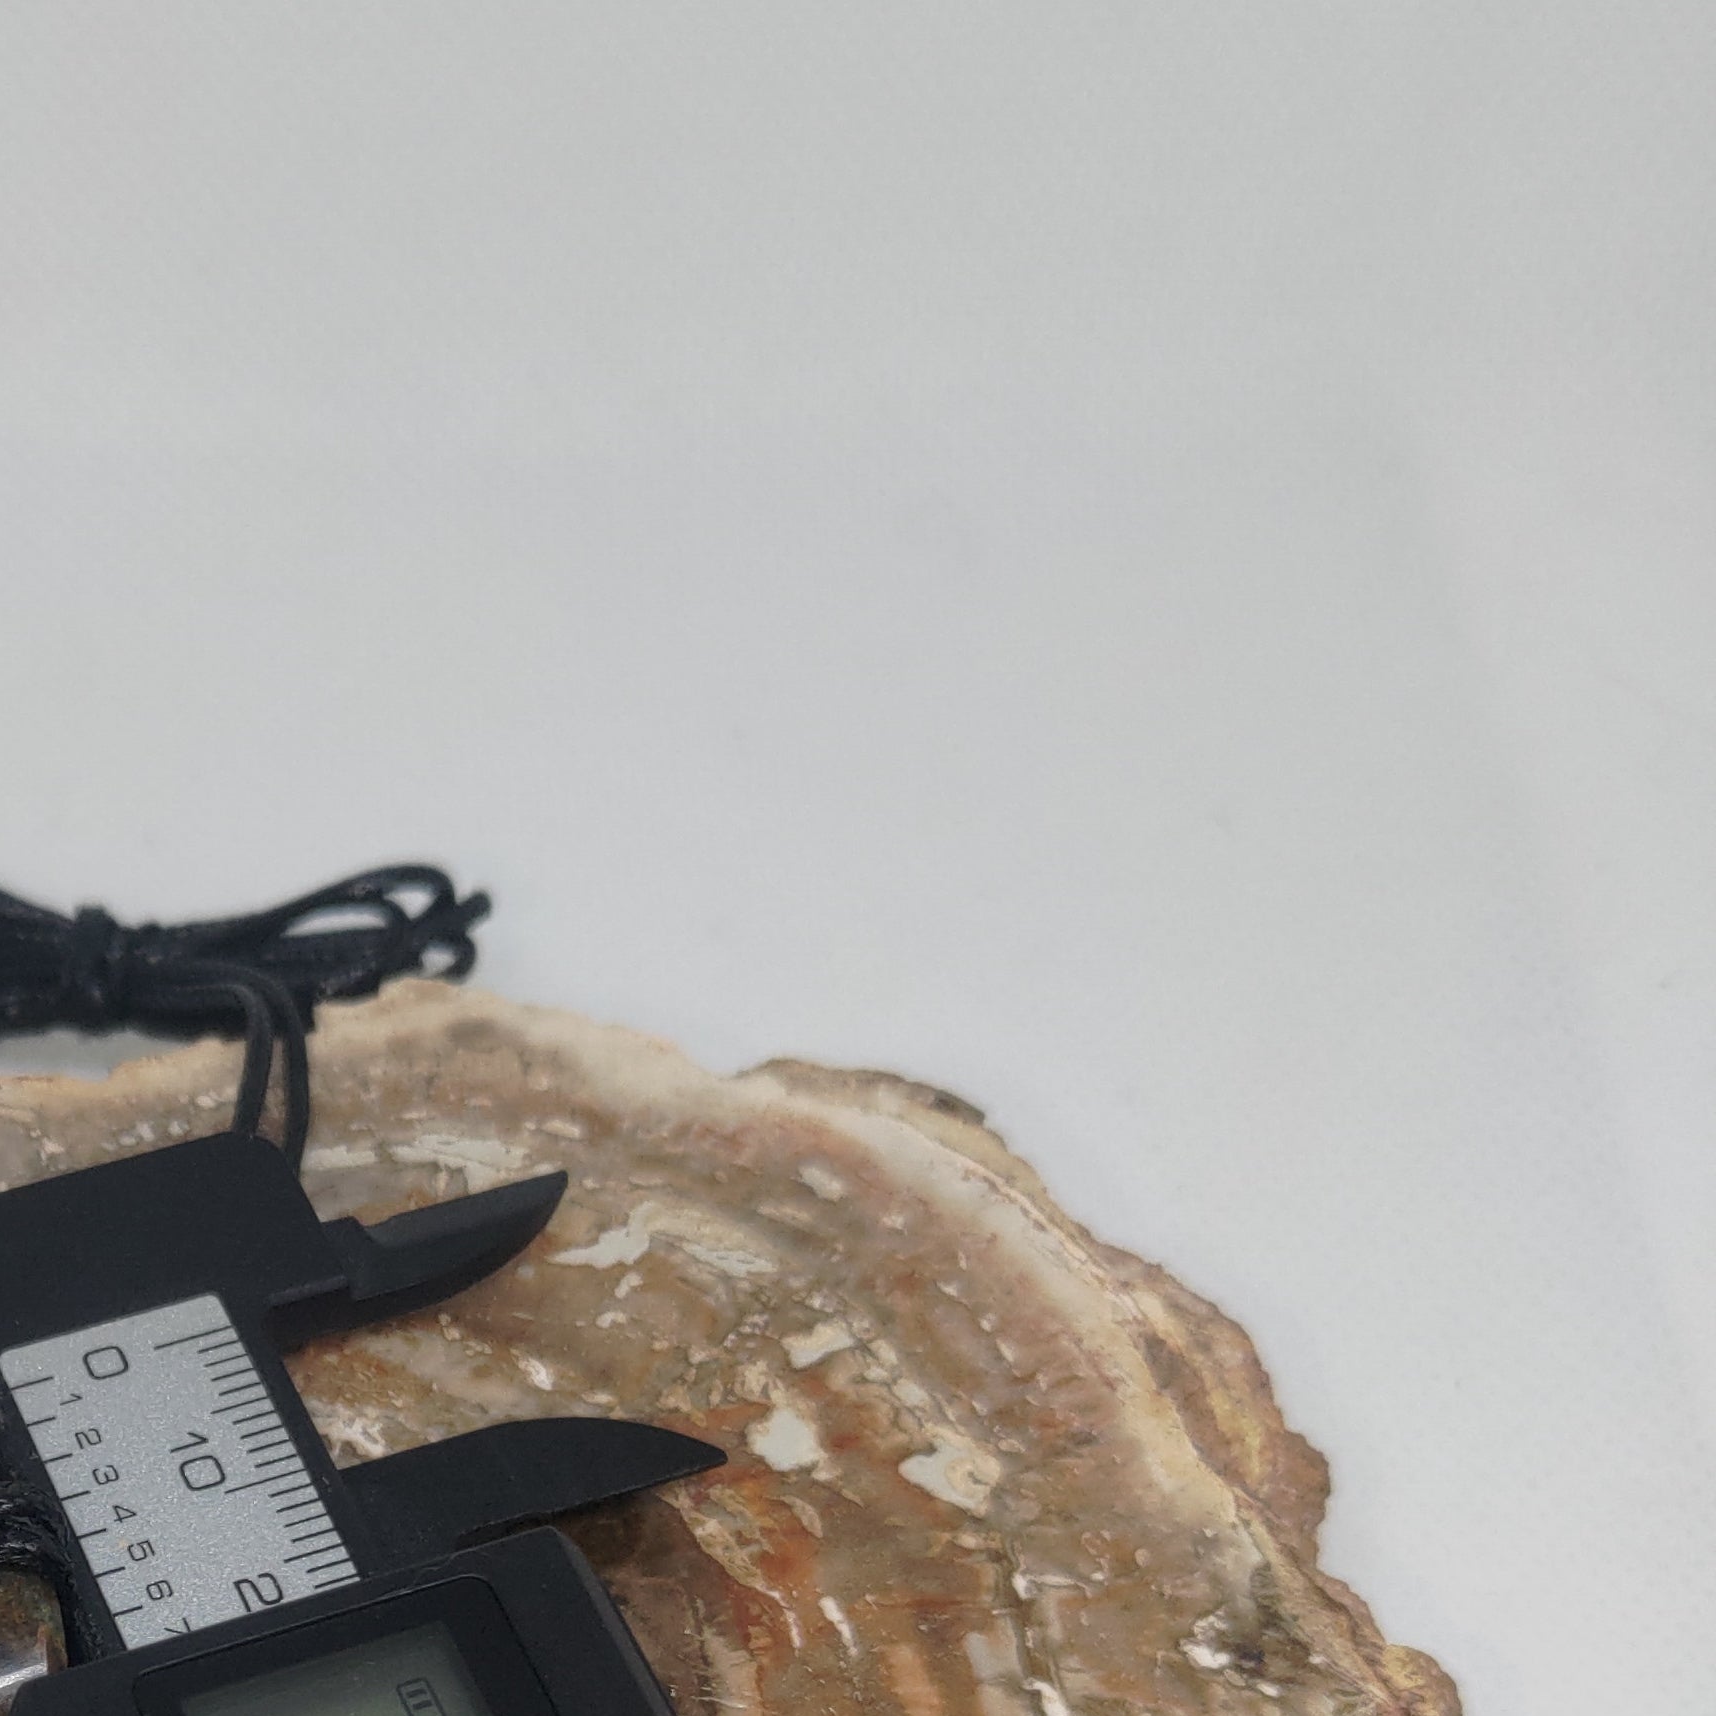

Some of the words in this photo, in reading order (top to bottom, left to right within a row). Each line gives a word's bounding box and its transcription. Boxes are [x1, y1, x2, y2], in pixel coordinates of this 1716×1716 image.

[82, 1345, 129, 1381] 0
[169, 1431, 226, 1491] 10
[74, 1428, 102, 1449] 2
[92, 1464, 120, 1486] 3
[112, 1504, 137, 1524] 4
[127, 1539, 155, 1562] 5
[146, 1579, 173, 1601] 6
